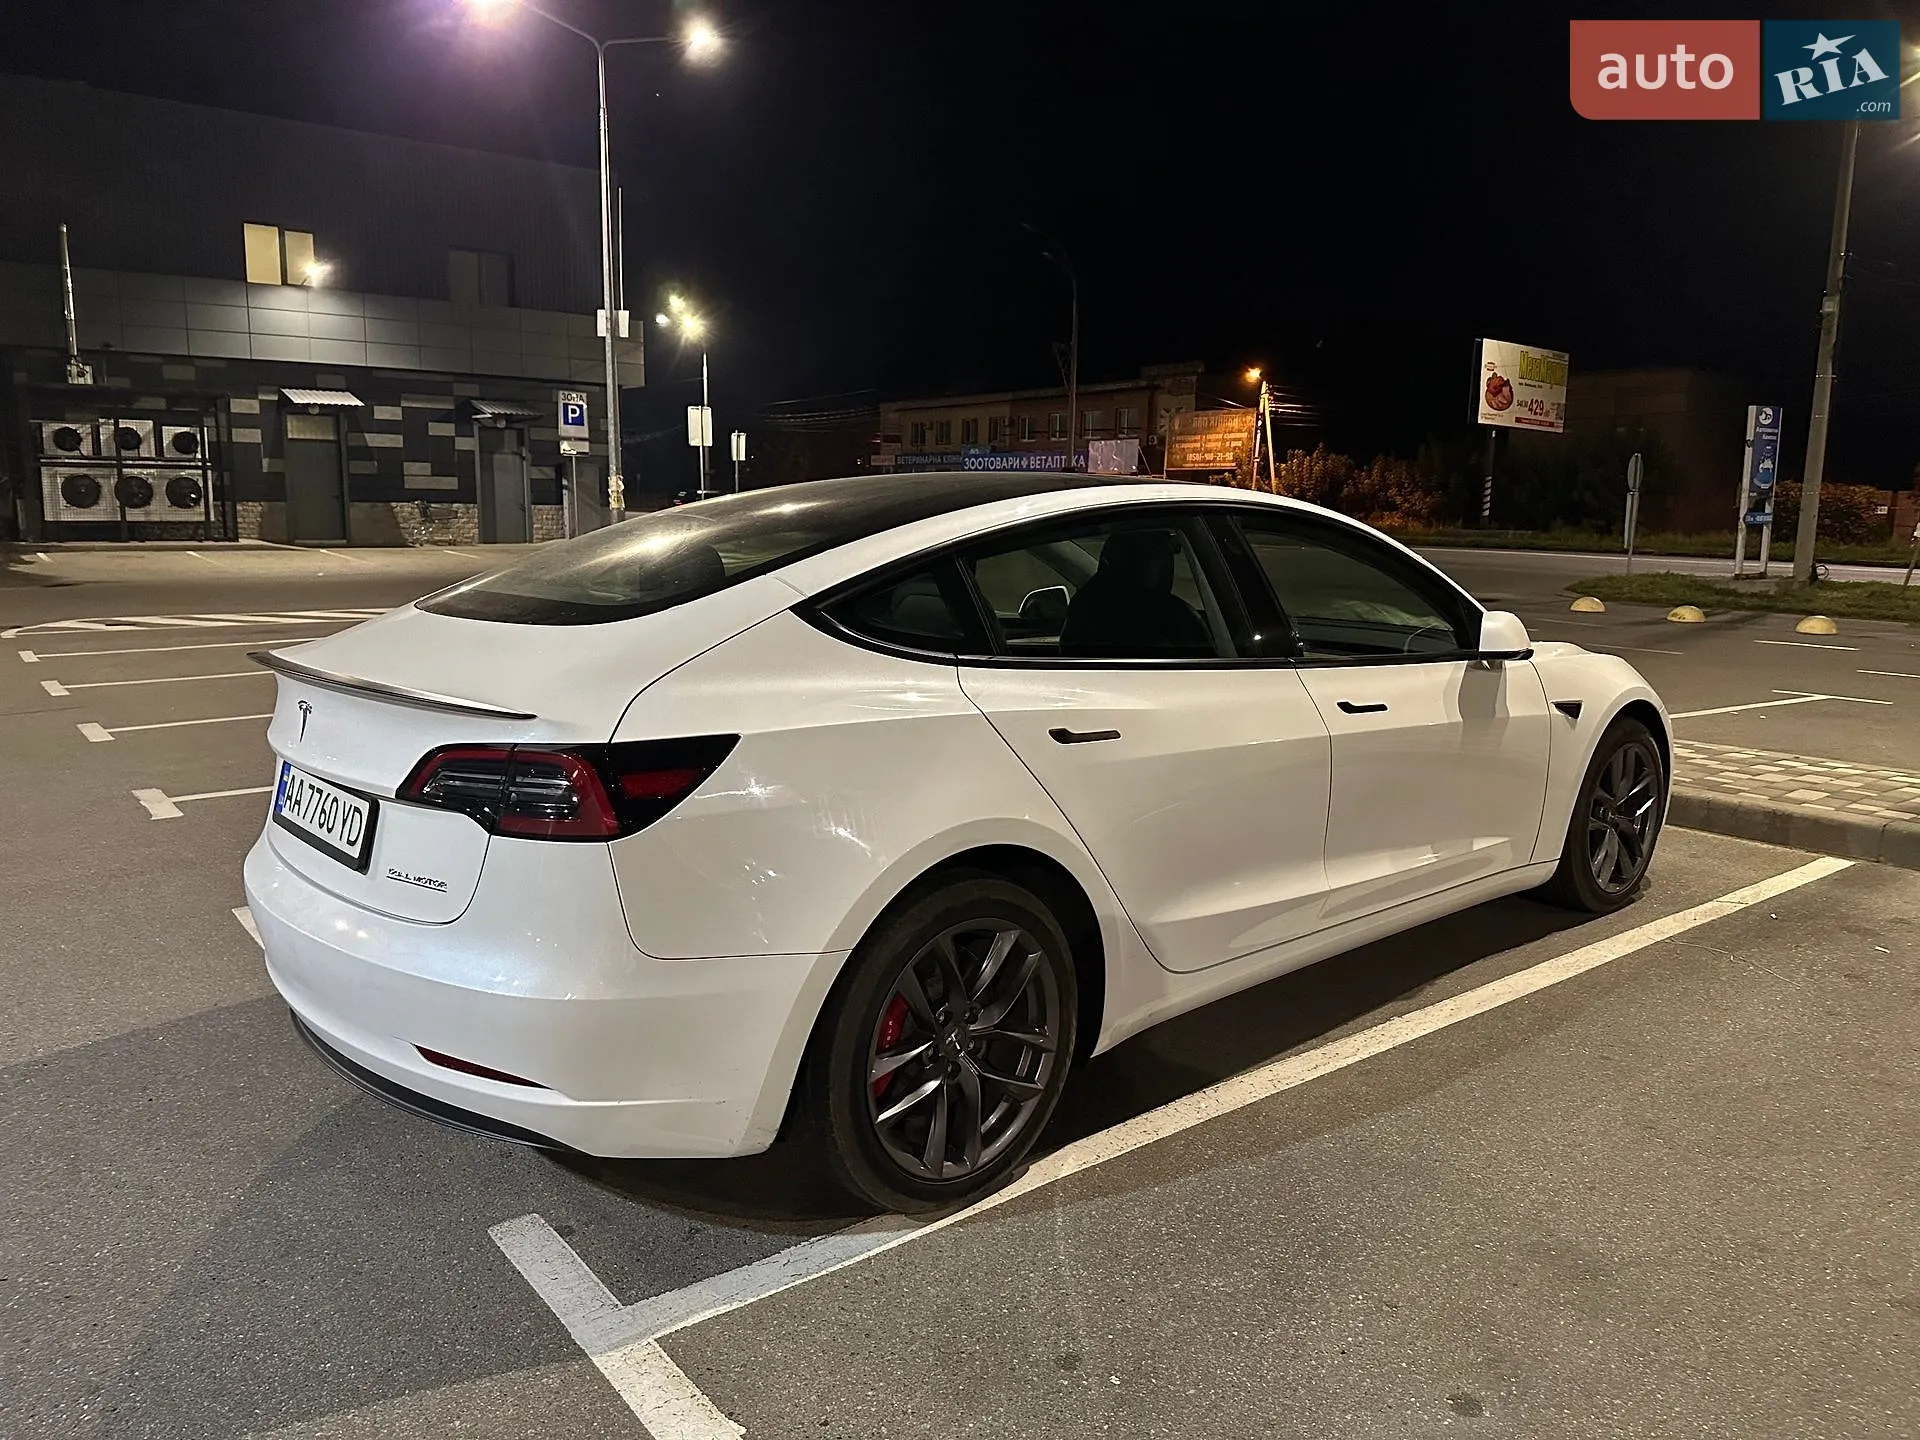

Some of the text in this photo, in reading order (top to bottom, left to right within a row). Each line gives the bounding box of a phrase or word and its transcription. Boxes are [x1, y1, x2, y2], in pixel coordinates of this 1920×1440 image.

[568, 405, 580, 423] P
[963, 455, 1086, 470] ЗООТОВАРИ ВЕТАПТКА
[285, 774, 364, 847] AA 7760 YD
